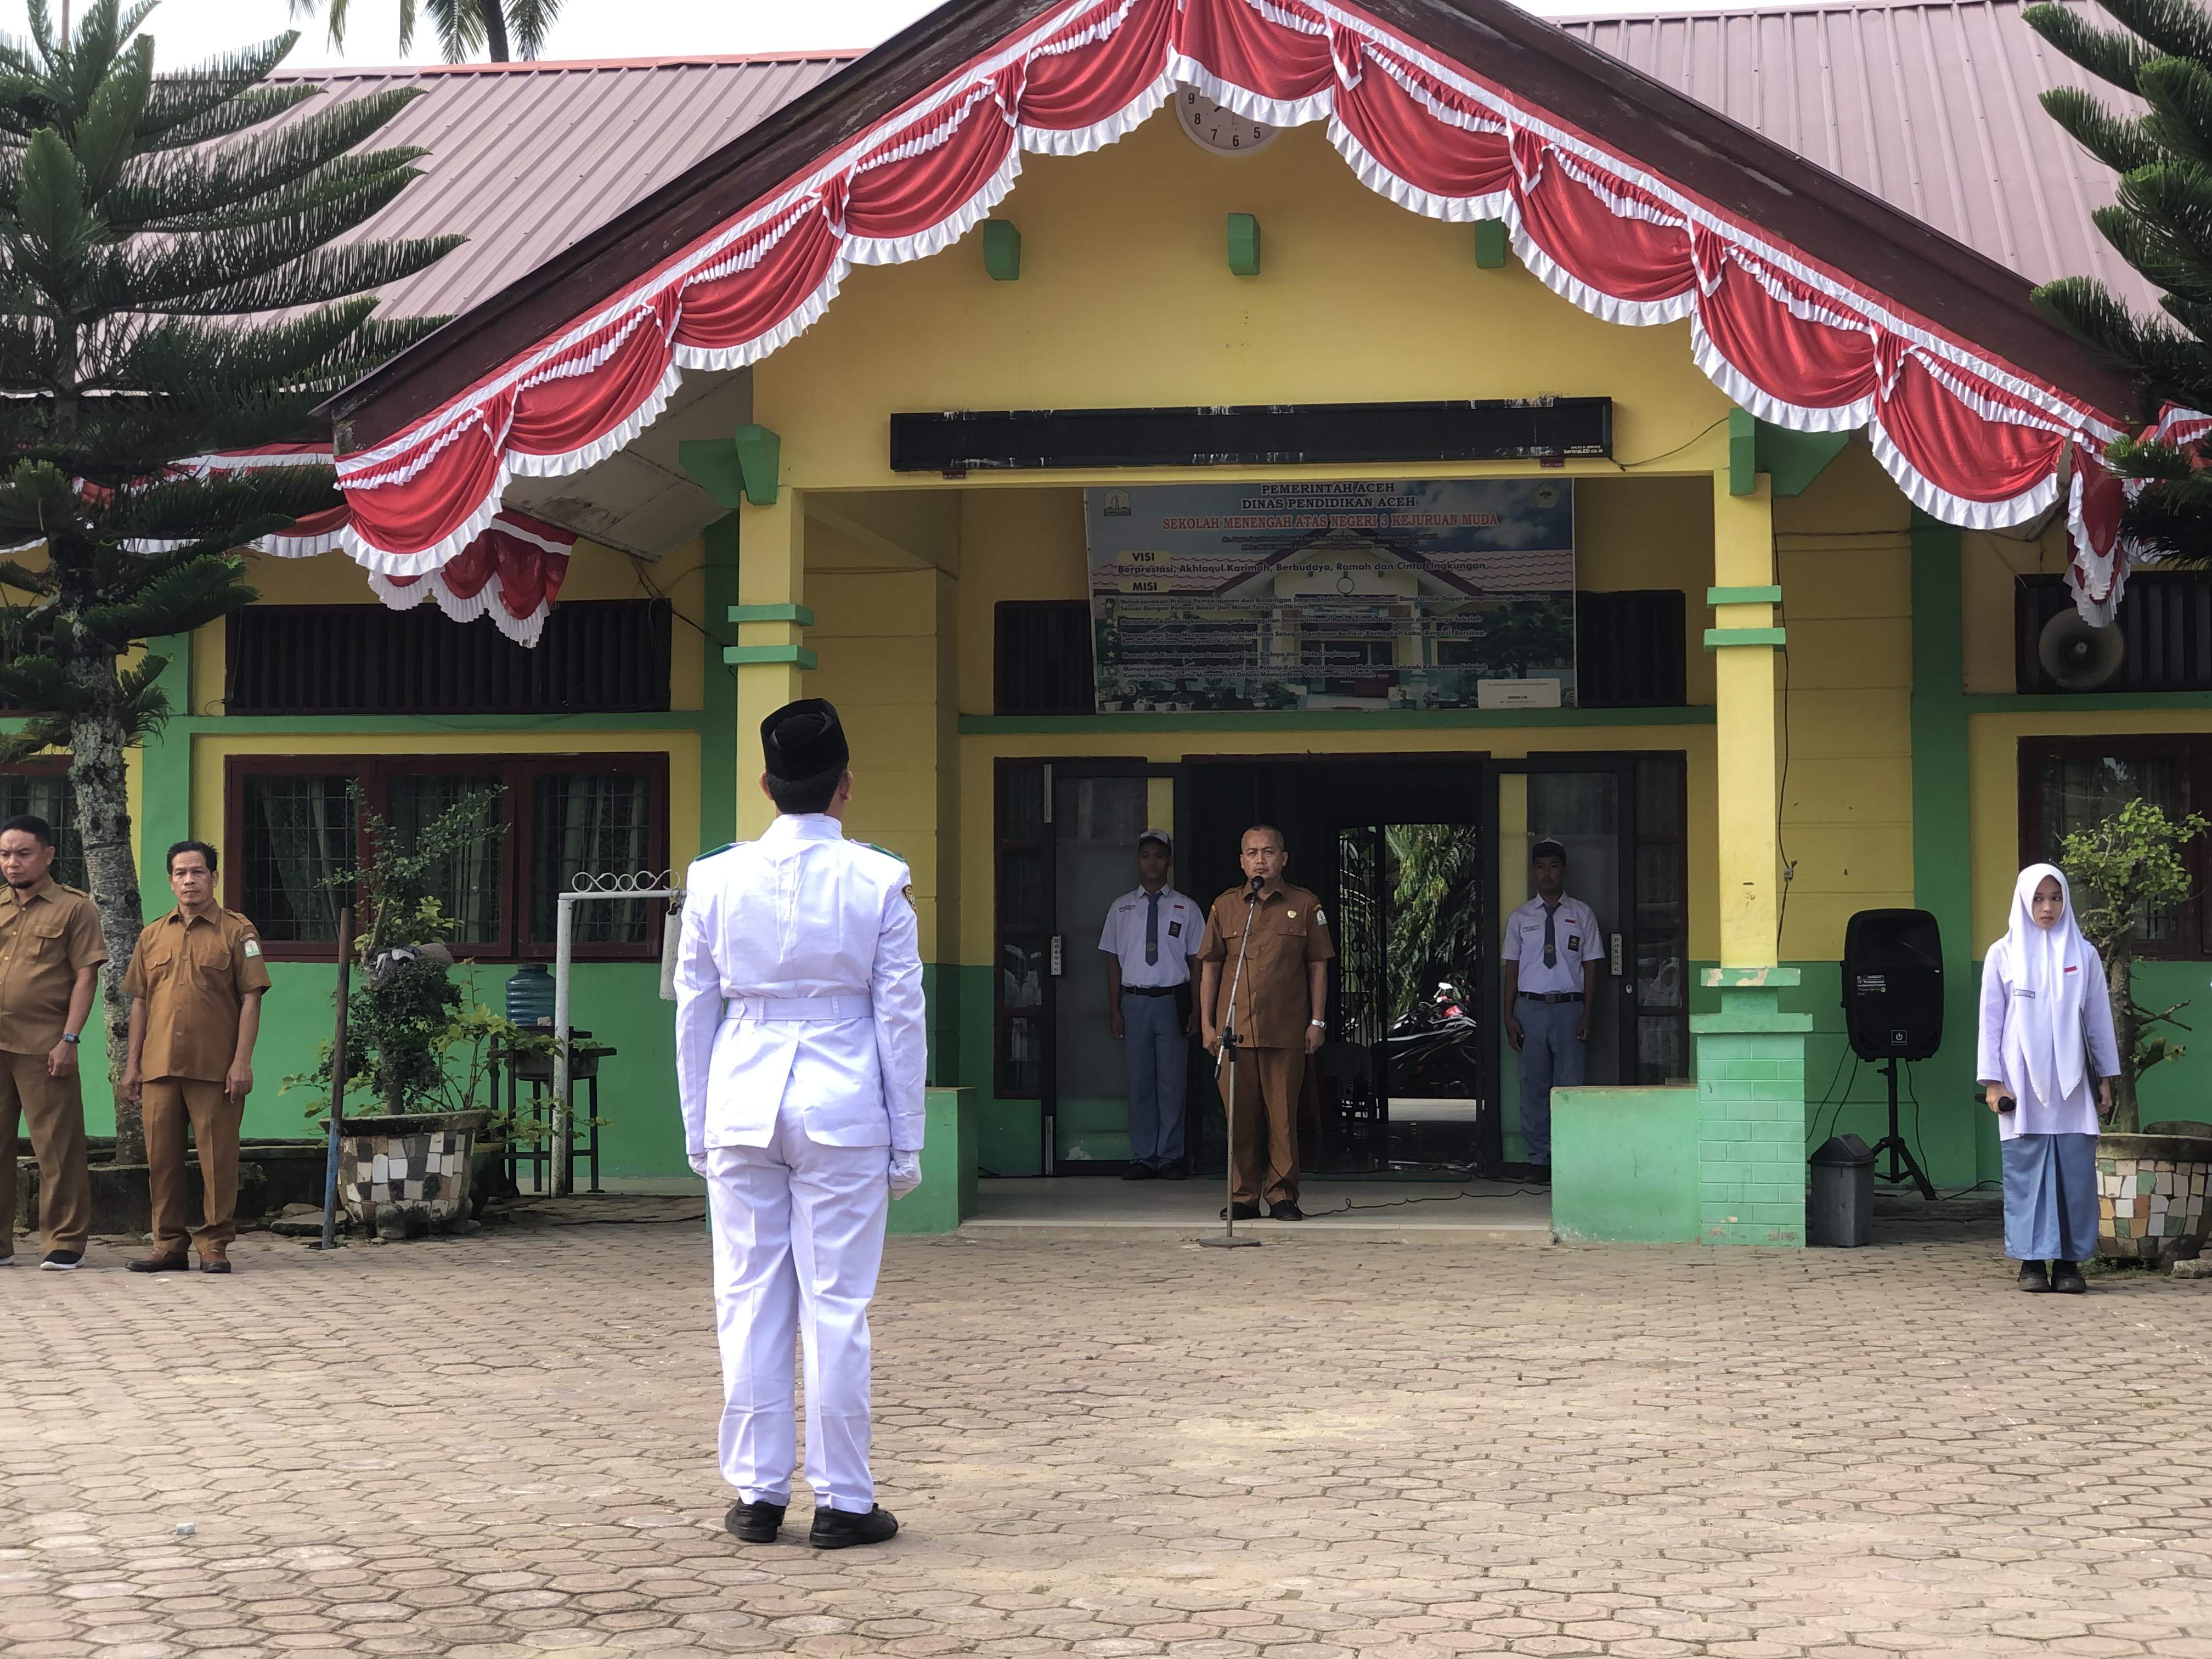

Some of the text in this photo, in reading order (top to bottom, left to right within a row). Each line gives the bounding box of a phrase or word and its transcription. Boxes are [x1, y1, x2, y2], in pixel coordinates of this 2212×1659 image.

[1188, 93, 1195, 104] 9
[1194, 113, 1201, 125] 8
[1211, 129, 1218, 140] 7
[1254, 127, 1261, 139] 5
[1233, 135, 1239, 147] 6
[1261, 483, 1396, 494] PEMERINTAH ACEH
[1242, 496, 1416, 510] DINAS PENDIDIKAN ACEH
[1163, 513, 1498, 529] SEKOLAH MENENGAH ATAS NEGERI 3 KEJURUAN MUDA
[1132, 552, 1155, 561] VISI
[1118, 565, 1176, 574] Berprestasi,
[1276, 563, 1333, 572] Berbudaya,
[1336, 562, 1372, 571] Ramah
[1374, 562, 1393, 570] dan
[1397, 561, 1423, 569] Cinta
[1132, 582, 1158, 591] MISI
